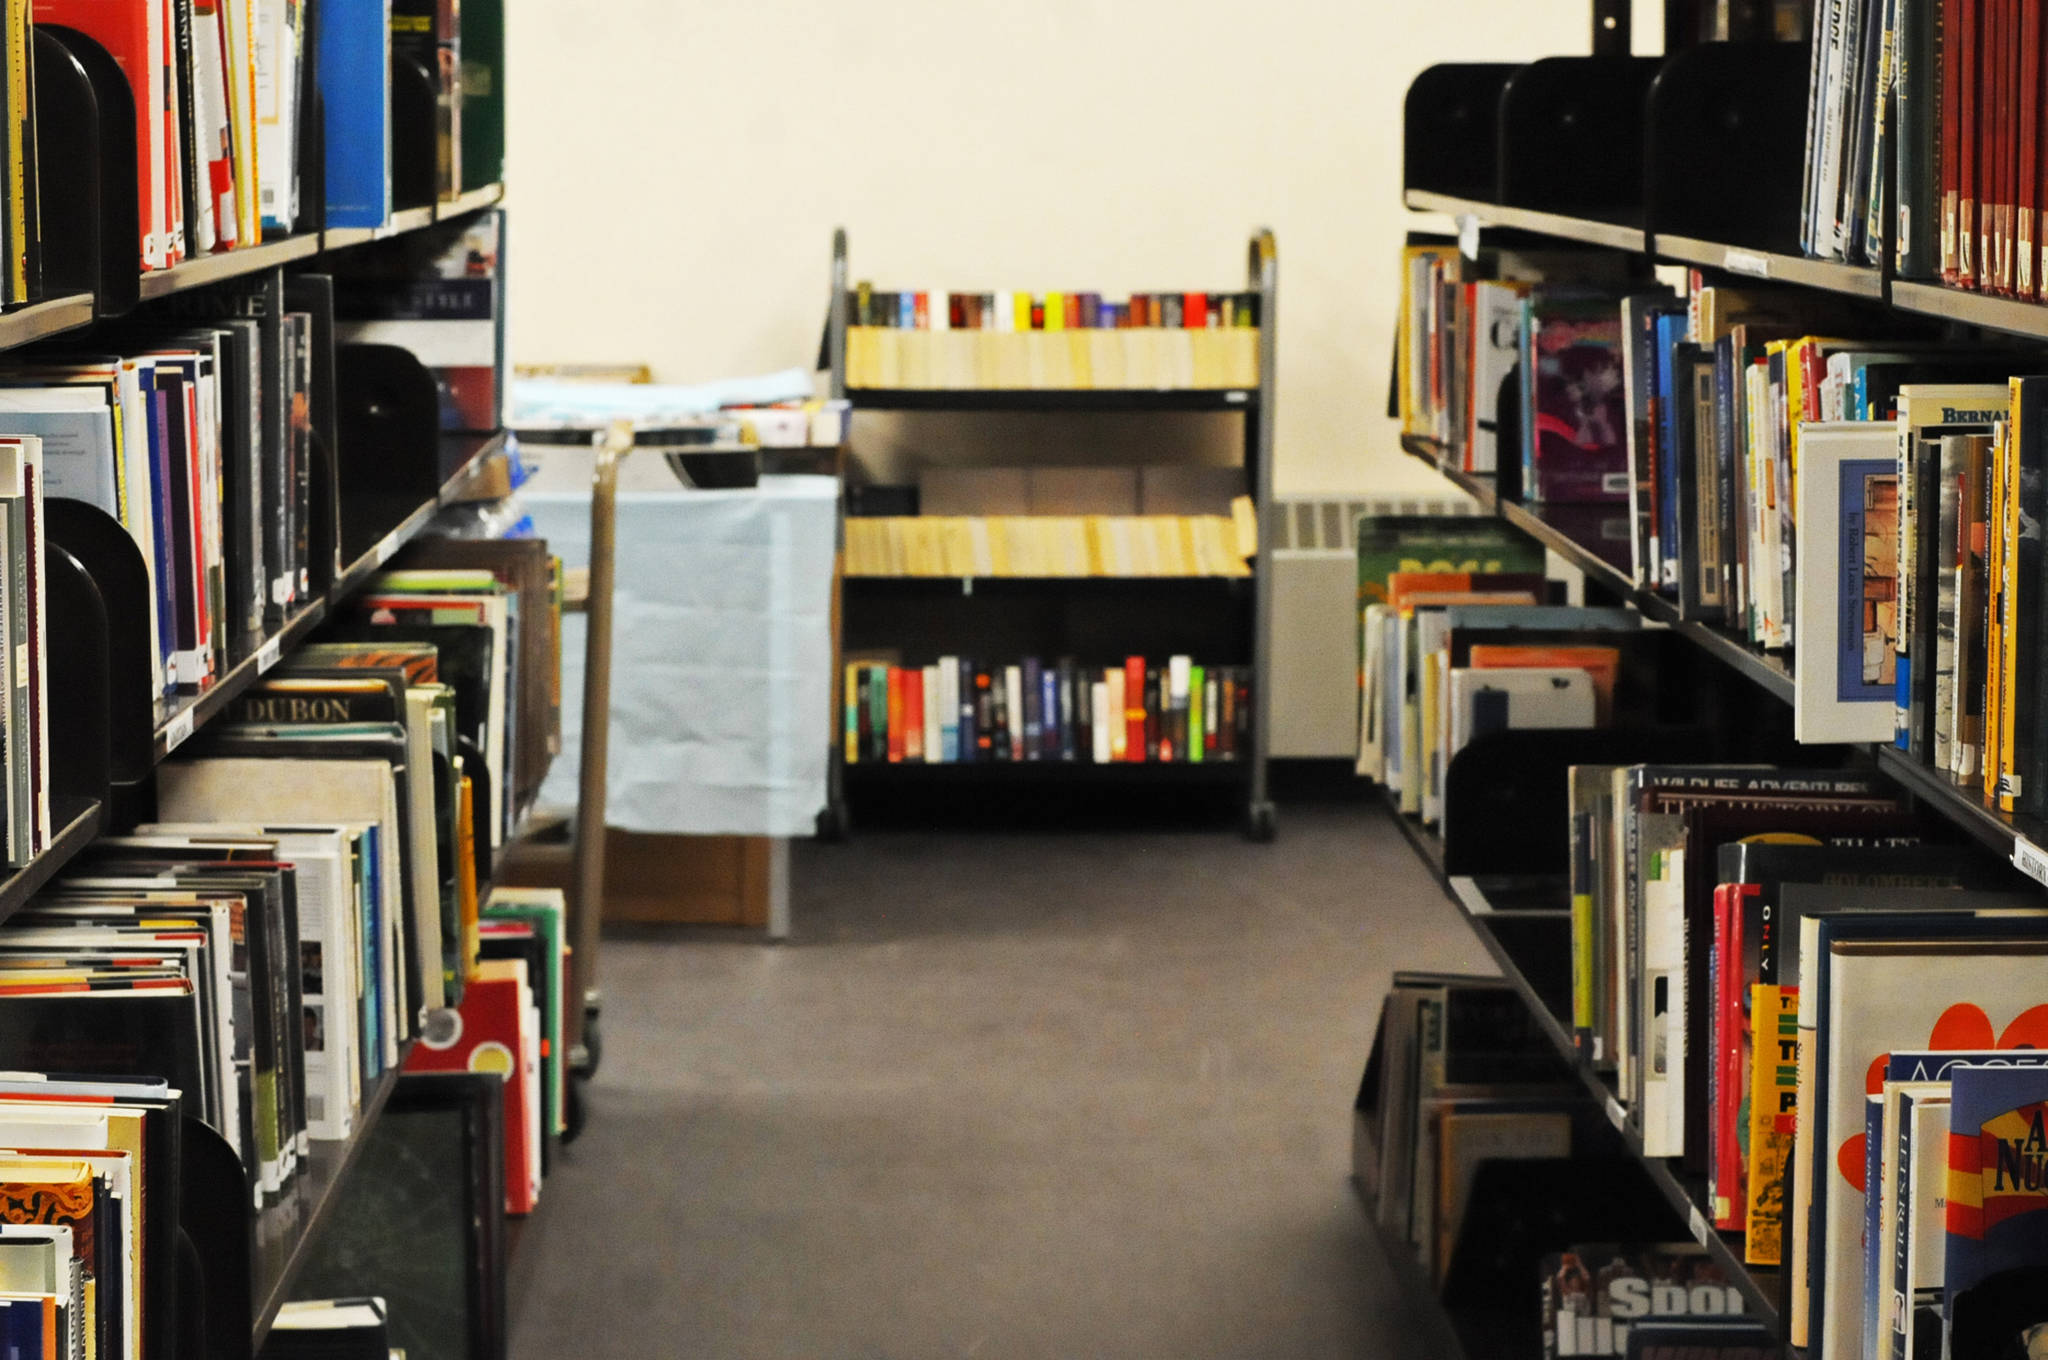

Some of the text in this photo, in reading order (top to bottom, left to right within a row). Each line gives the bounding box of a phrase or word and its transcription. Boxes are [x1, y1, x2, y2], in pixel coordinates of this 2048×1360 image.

[1848, 528, 1858, 564] Robert
[1848, 567, 1858, 593] Louis
[1848, 598, 1858, 652] Stevenson
[1897, 1133, 1908, 1269] LET'S ROLL!
